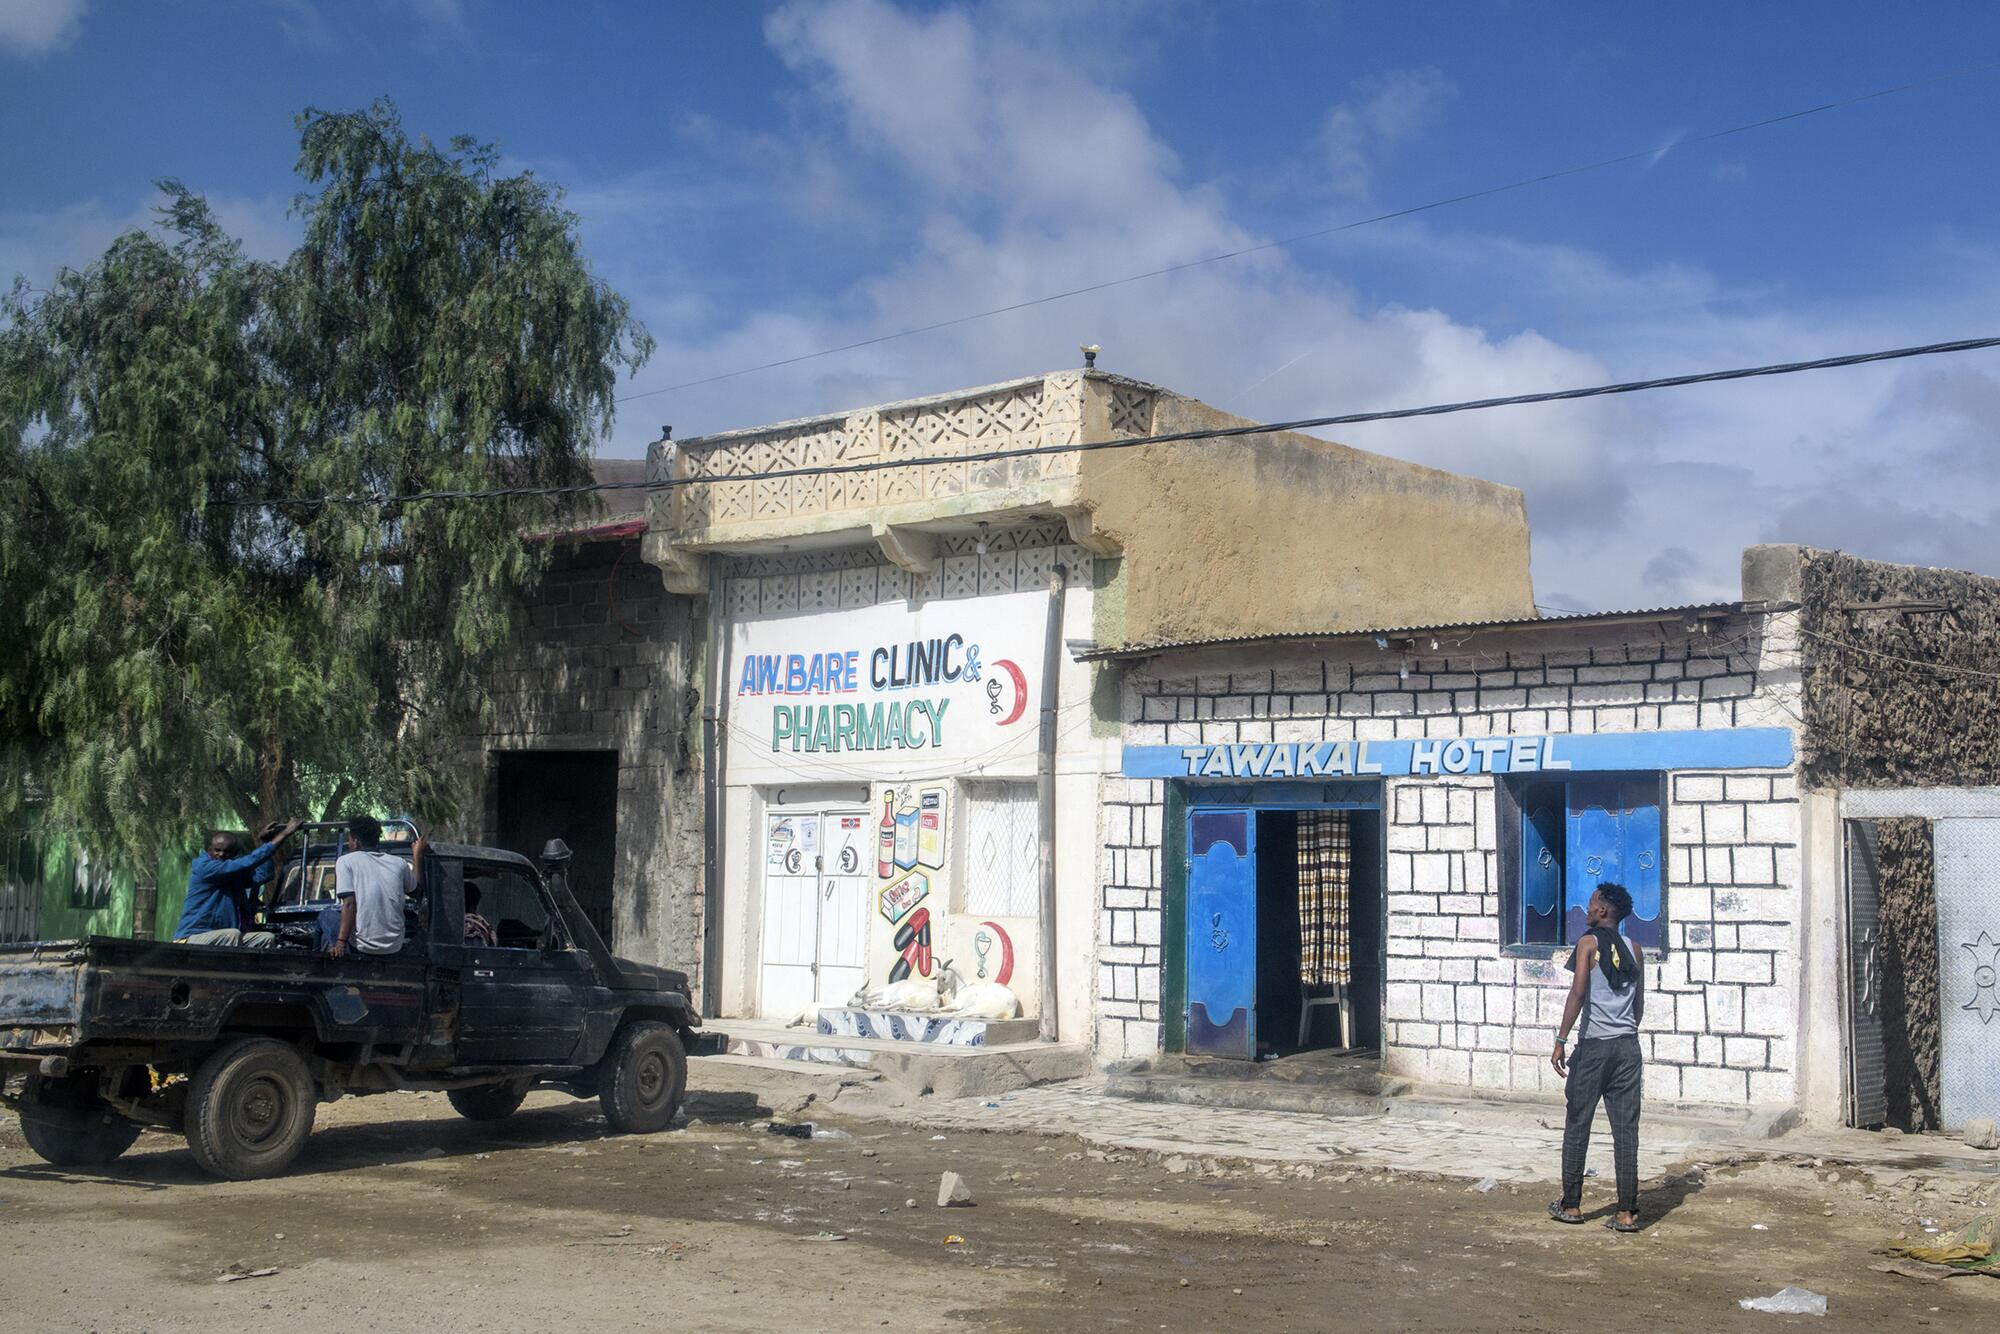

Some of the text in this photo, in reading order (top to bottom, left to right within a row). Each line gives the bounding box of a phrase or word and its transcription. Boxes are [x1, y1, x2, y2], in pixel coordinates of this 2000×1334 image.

[738, 651, 859, 697] AW.BARE
[772, 698, 950, 752] PHARMACY
[1181, 736, 1572, 777] TAWAKAL HOTEL
